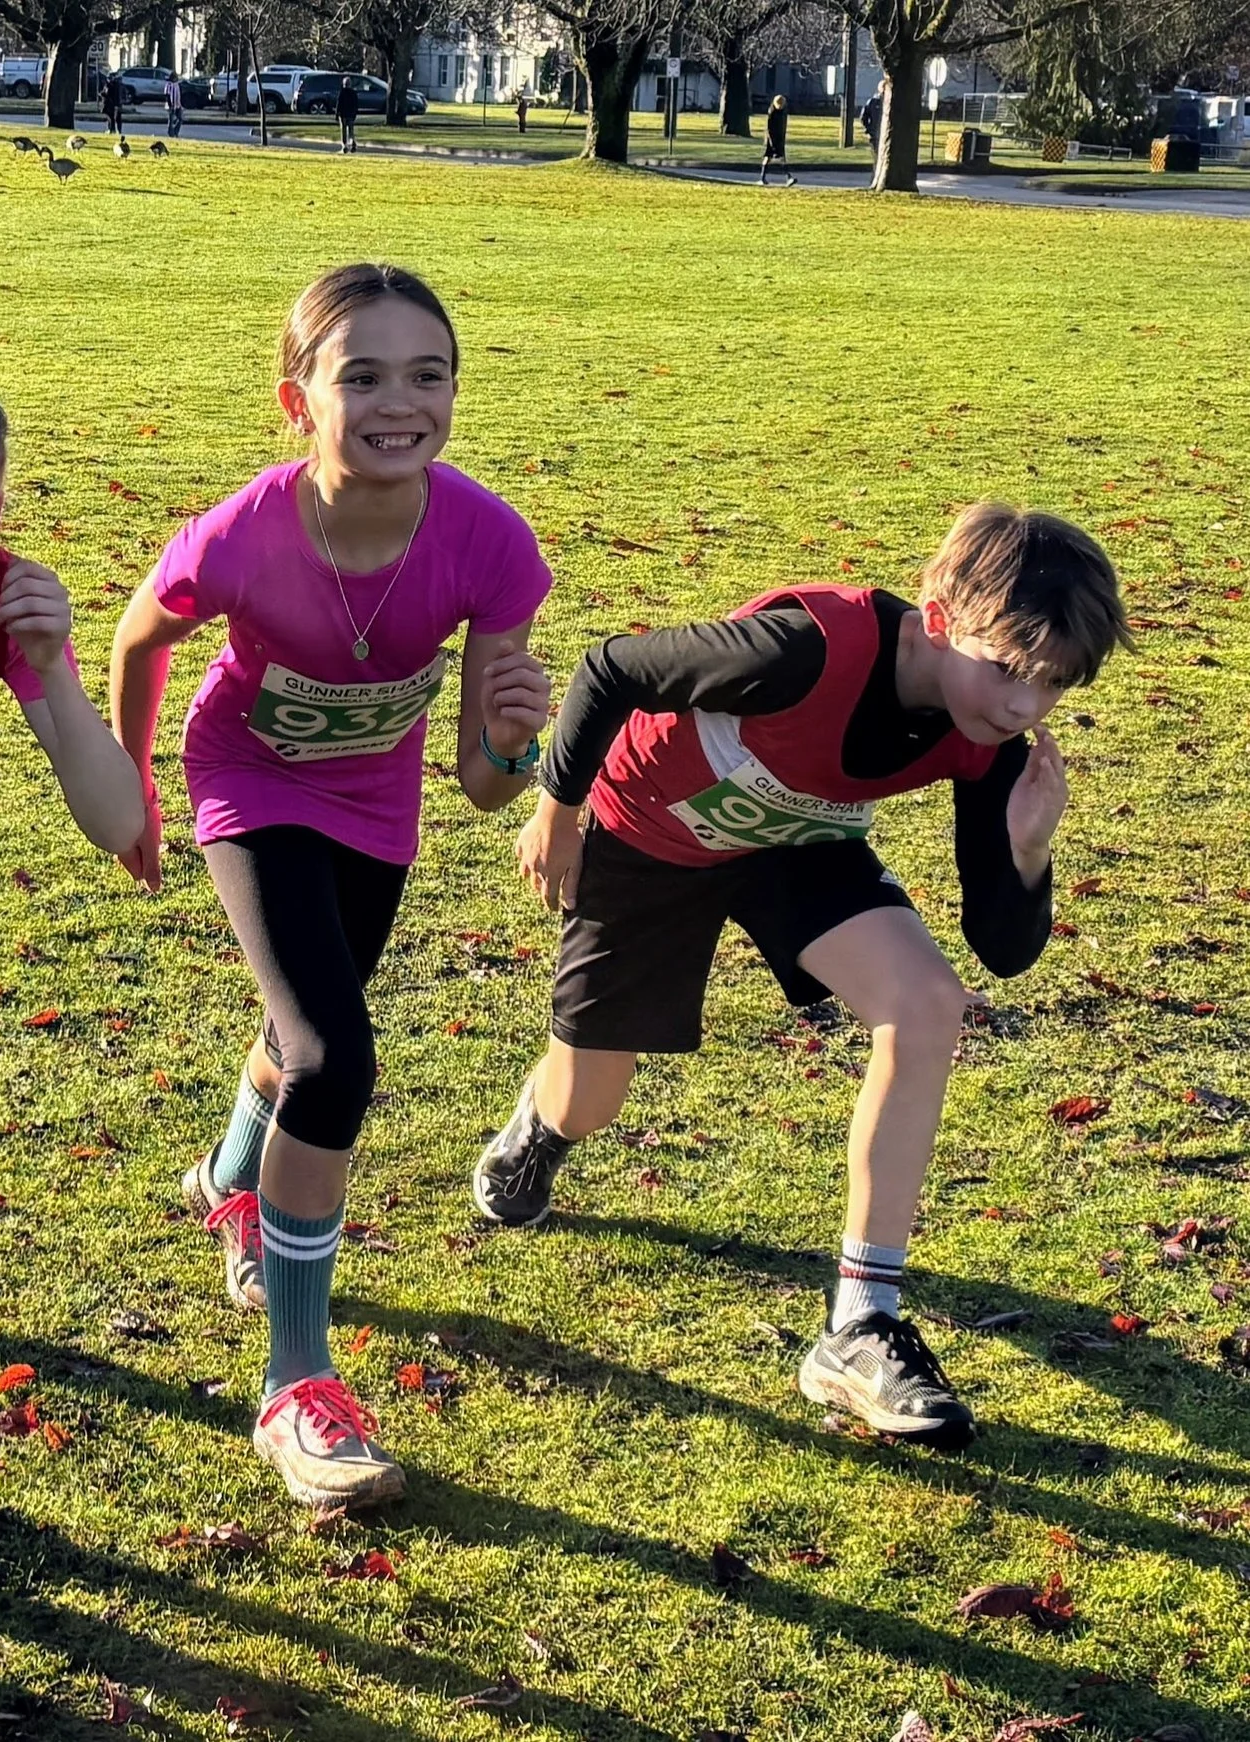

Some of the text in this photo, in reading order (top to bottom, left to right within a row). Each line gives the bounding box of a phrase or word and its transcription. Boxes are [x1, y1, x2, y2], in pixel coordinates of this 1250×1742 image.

[91, 41, 104, 52] 30
[285, 677, 371, 698] GUNNER
[376, 667, 434, 695] SHAW
[270, 693, 428, 737] 932
[755, 776, 823, 810] GUNNER
[823, 802, 864, 813] SHAW
